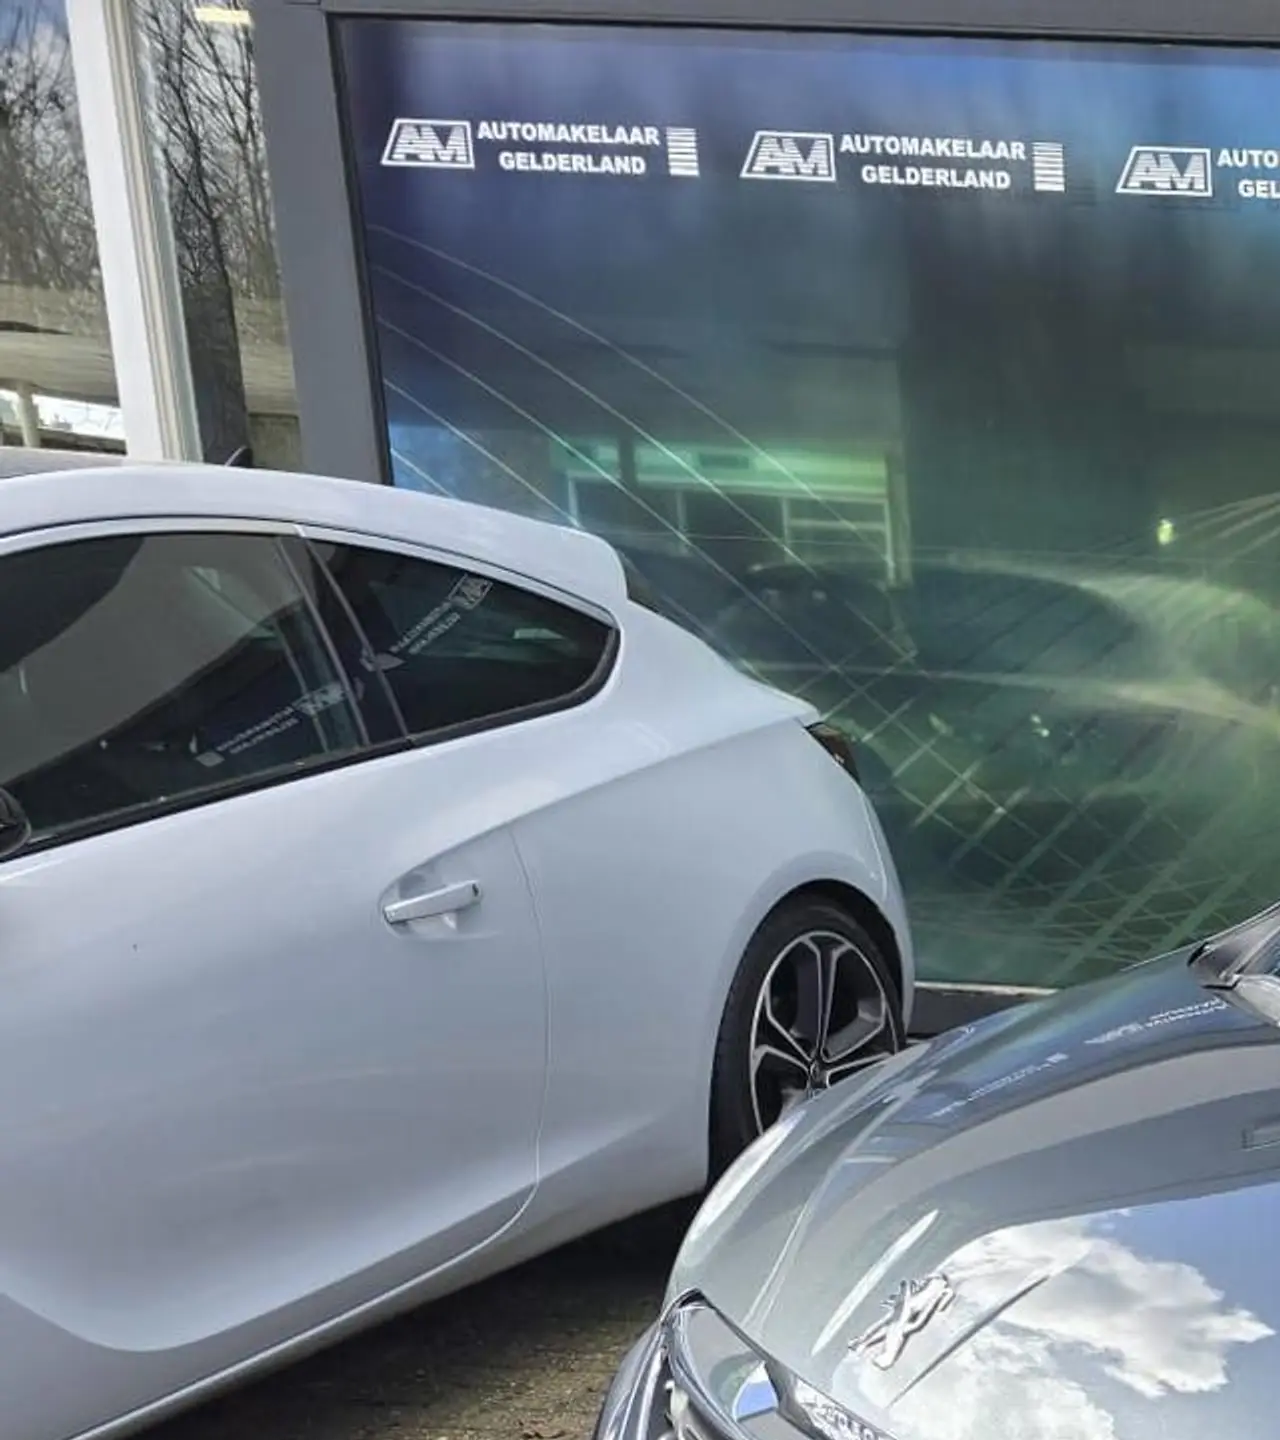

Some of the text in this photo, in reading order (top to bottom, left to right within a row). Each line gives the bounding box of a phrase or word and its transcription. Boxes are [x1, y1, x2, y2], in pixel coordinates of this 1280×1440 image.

[391, 124, 467, 163] AM
[477, 120, 662, 147] AUTOMAKELAAR
[839, 133, 1028, 162] AUTOMAKELAAR
[498, 151, 647, 175] GELDERLAND
[752, 136, 832, 174] AM
[861, 164, 1012, 190] GELDERLAND
[1127, 151, 1205, 190] AM
